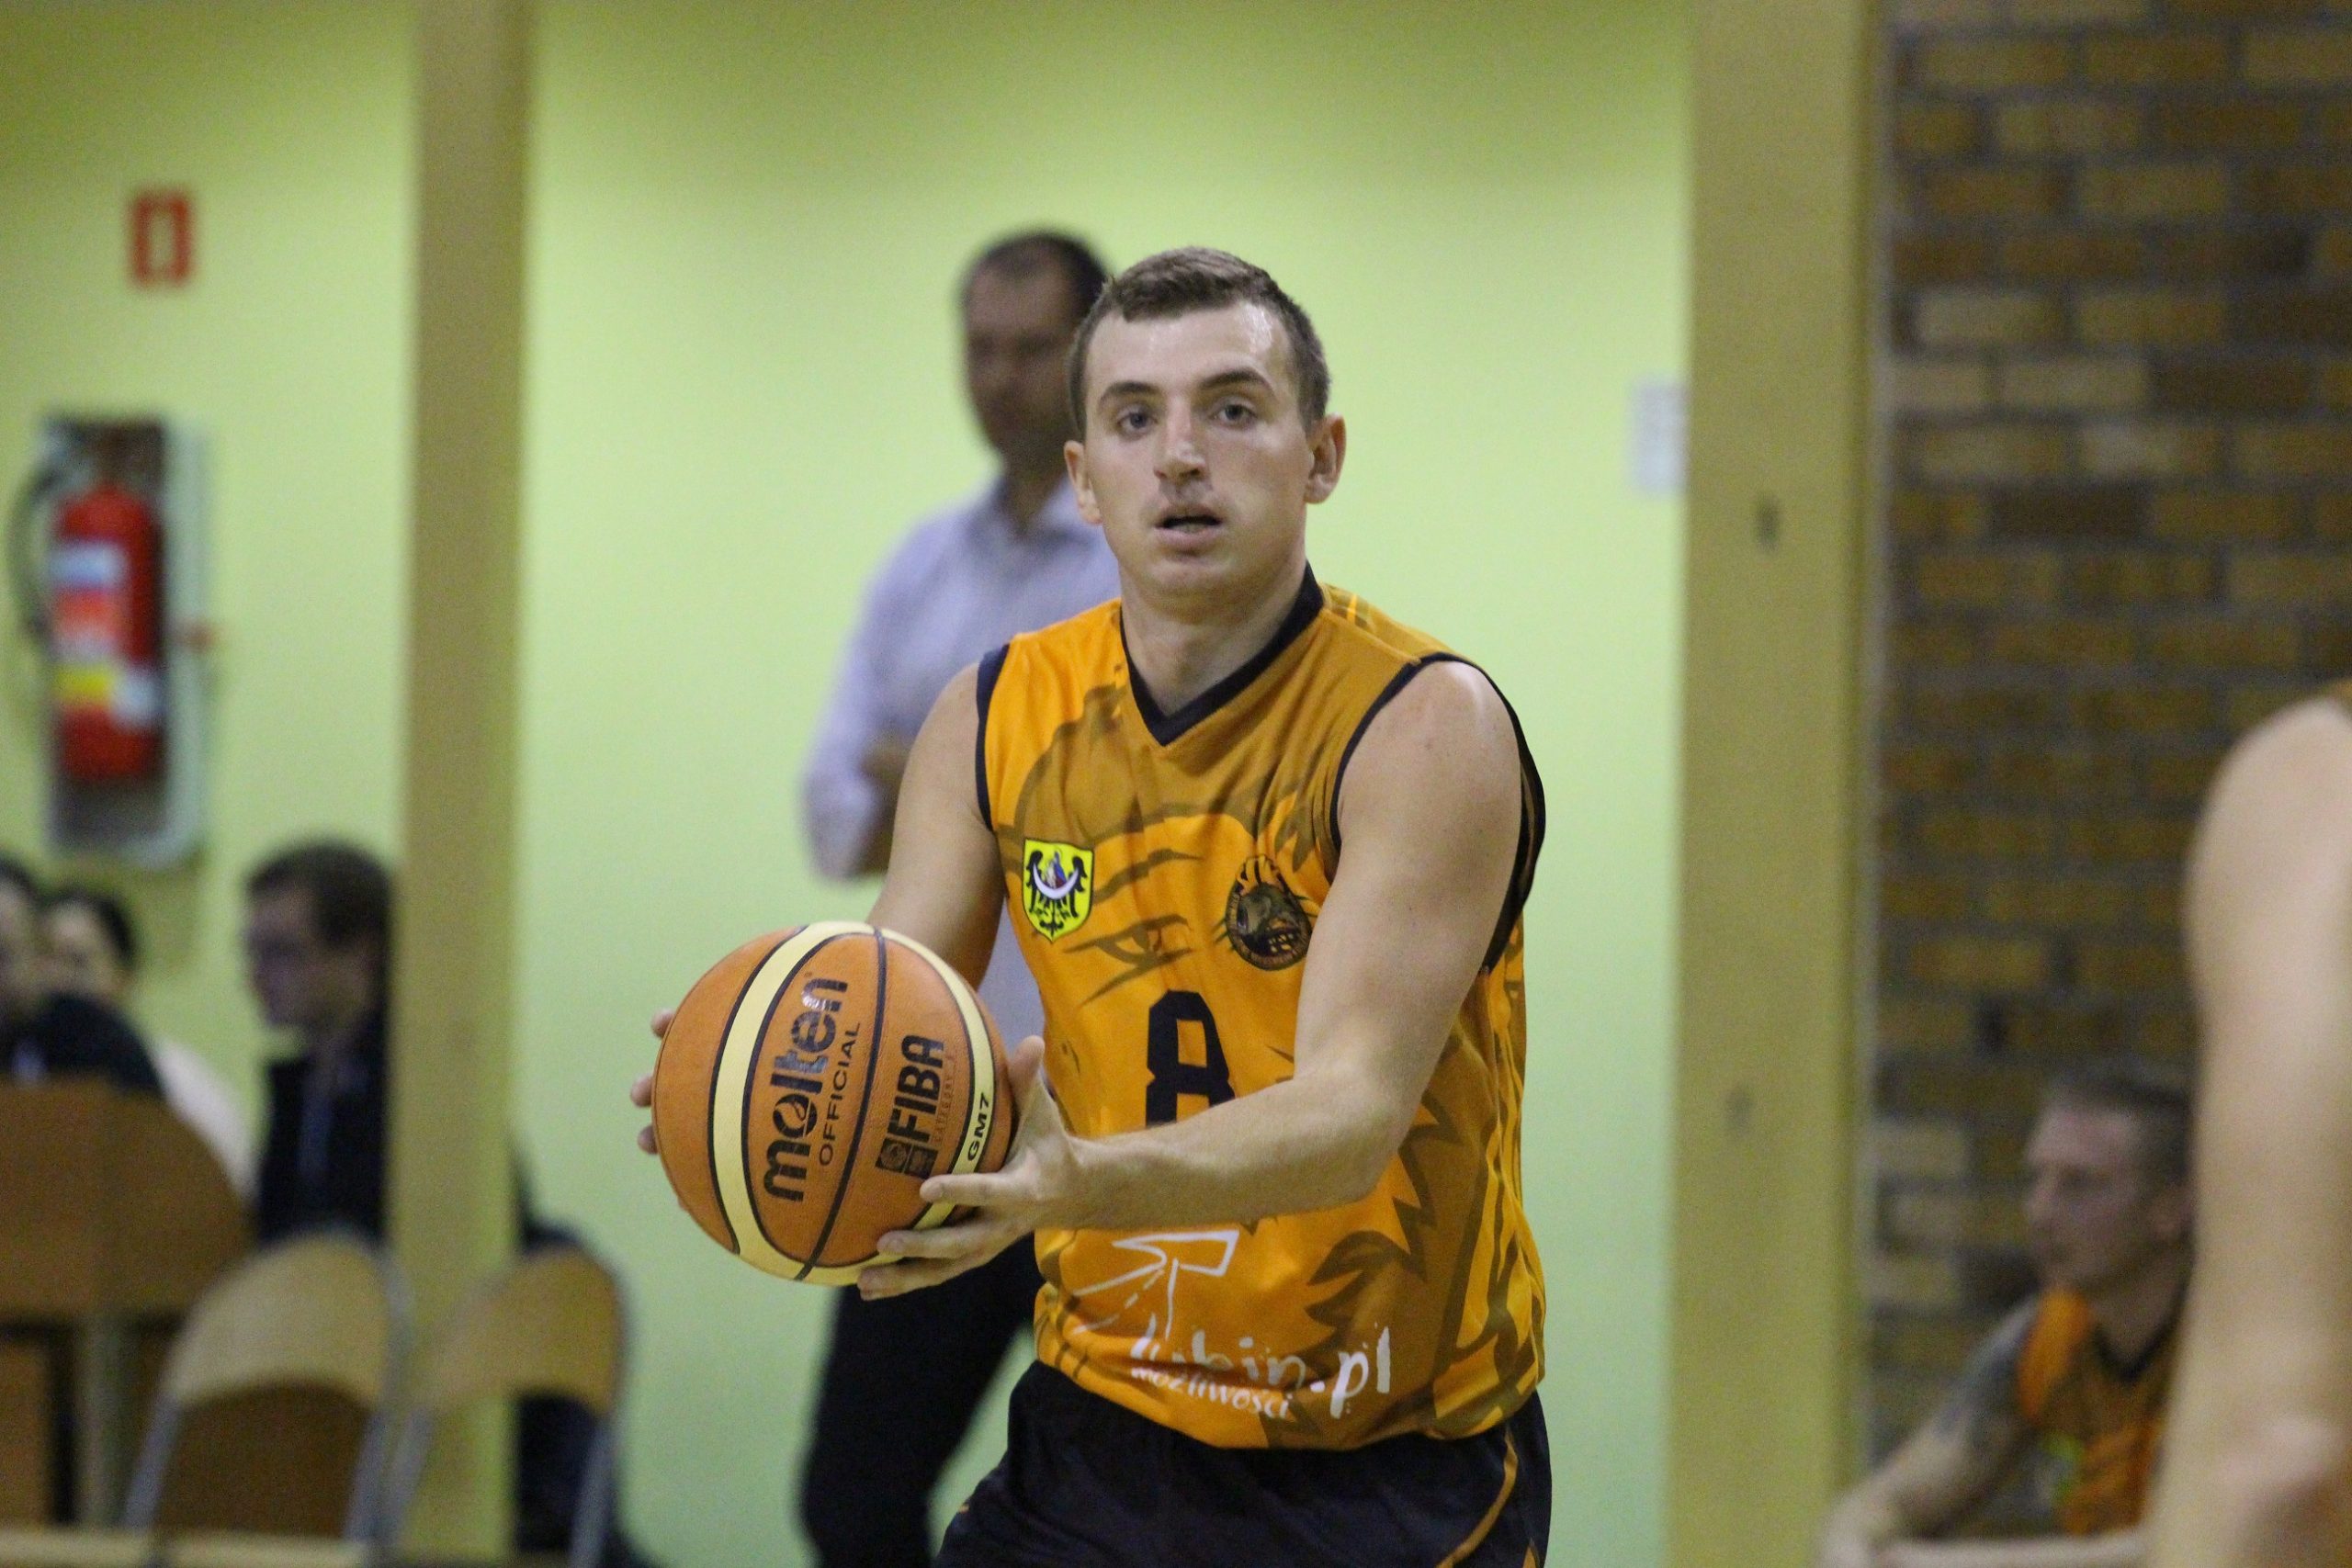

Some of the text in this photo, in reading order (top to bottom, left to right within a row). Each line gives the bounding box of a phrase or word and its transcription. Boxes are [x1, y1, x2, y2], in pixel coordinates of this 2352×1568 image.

[763, 978, 848, 1201] molten
[820, 1022, 860, 1166] OFFICIAL
[888, 1035, 944, 1143] FIBA
[967, 1092, 989, 1161] GM7
